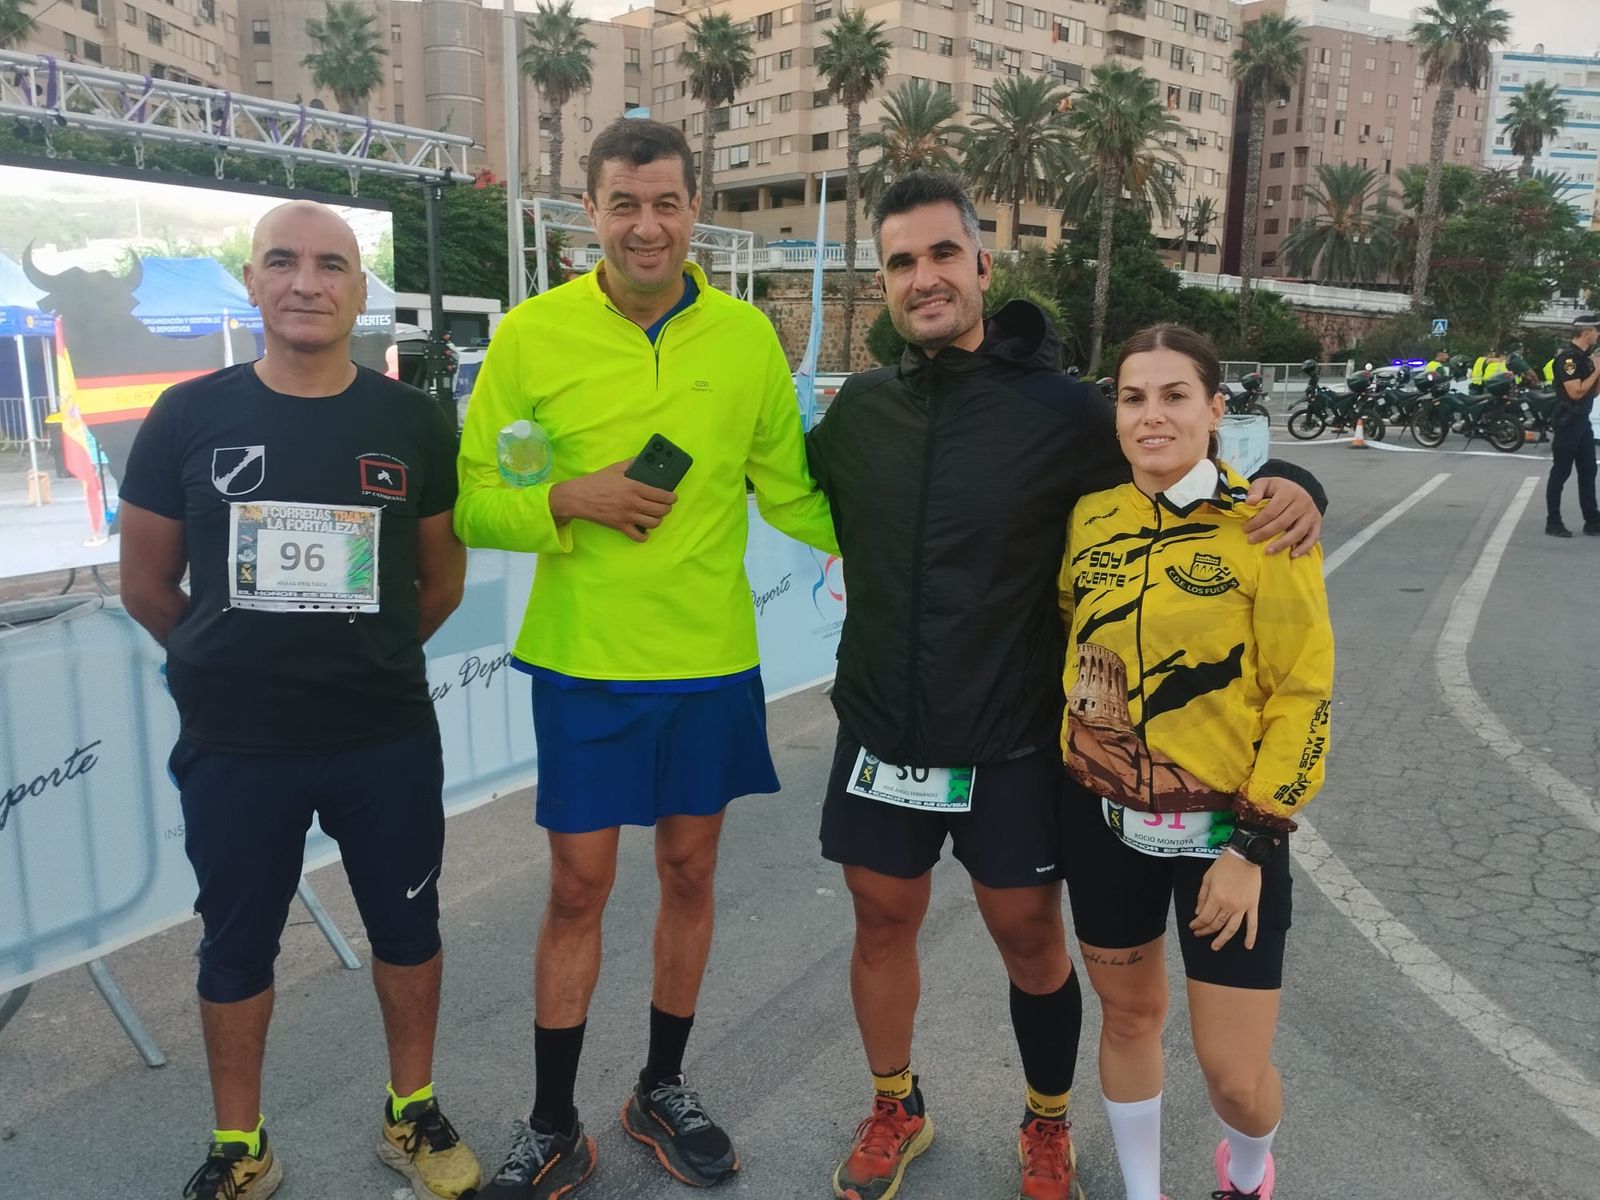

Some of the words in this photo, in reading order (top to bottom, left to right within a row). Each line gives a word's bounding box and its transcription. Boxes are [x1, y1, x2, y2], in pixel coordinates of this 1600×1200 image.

[267, 517, 284, 530] LA
[286, 518, 360, 535] FORTALEZA
[280, 541, 326, 572] 96
[1089, 550, 1123, 569] SOY
[1081, 571, 1126, 588] FUERTE
[1187, 584, 1203, 595] LOS
[1157, 837, 1195, 846] MONTOYA
